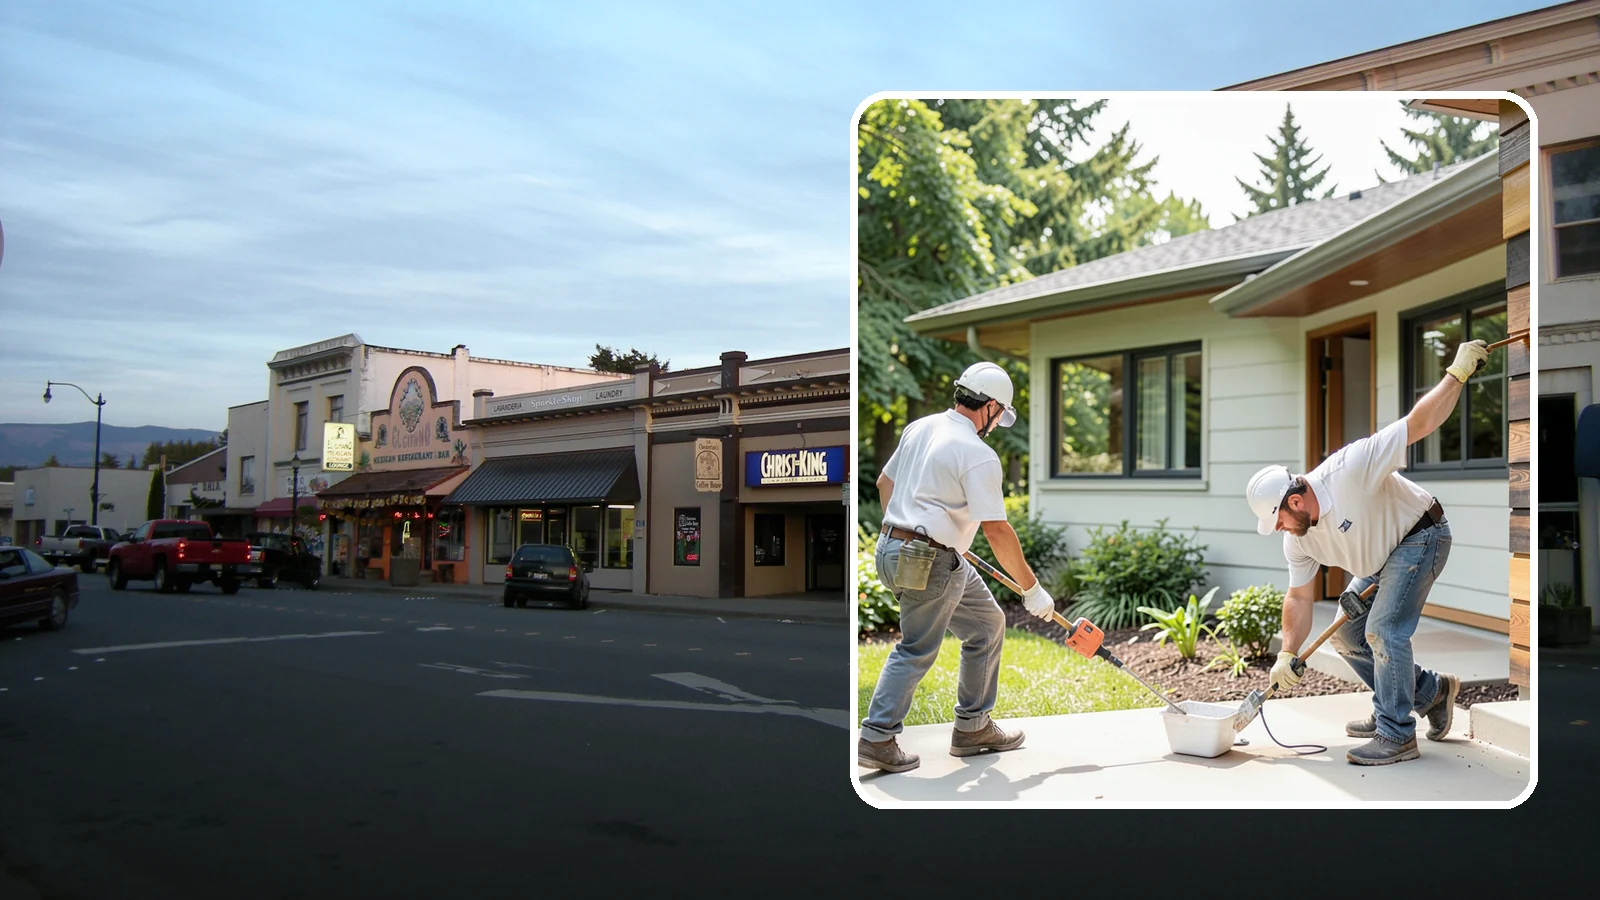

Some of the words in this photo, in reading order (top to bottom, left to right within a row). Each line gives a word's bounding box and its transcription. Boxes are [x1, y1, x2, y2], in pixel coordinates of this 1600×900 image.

[561, 394, 582, 404] Shop
[595, 389, 623, 400] LAUNDRY
[494, 402, 522, 412] LAVANDERIA
[398, 451, 433, 462] RESTAURANT
[438, 450, 450, 459] BAR
[760, 452, 798, 478] CHRIST
[799, 450, 827, 476] KING
